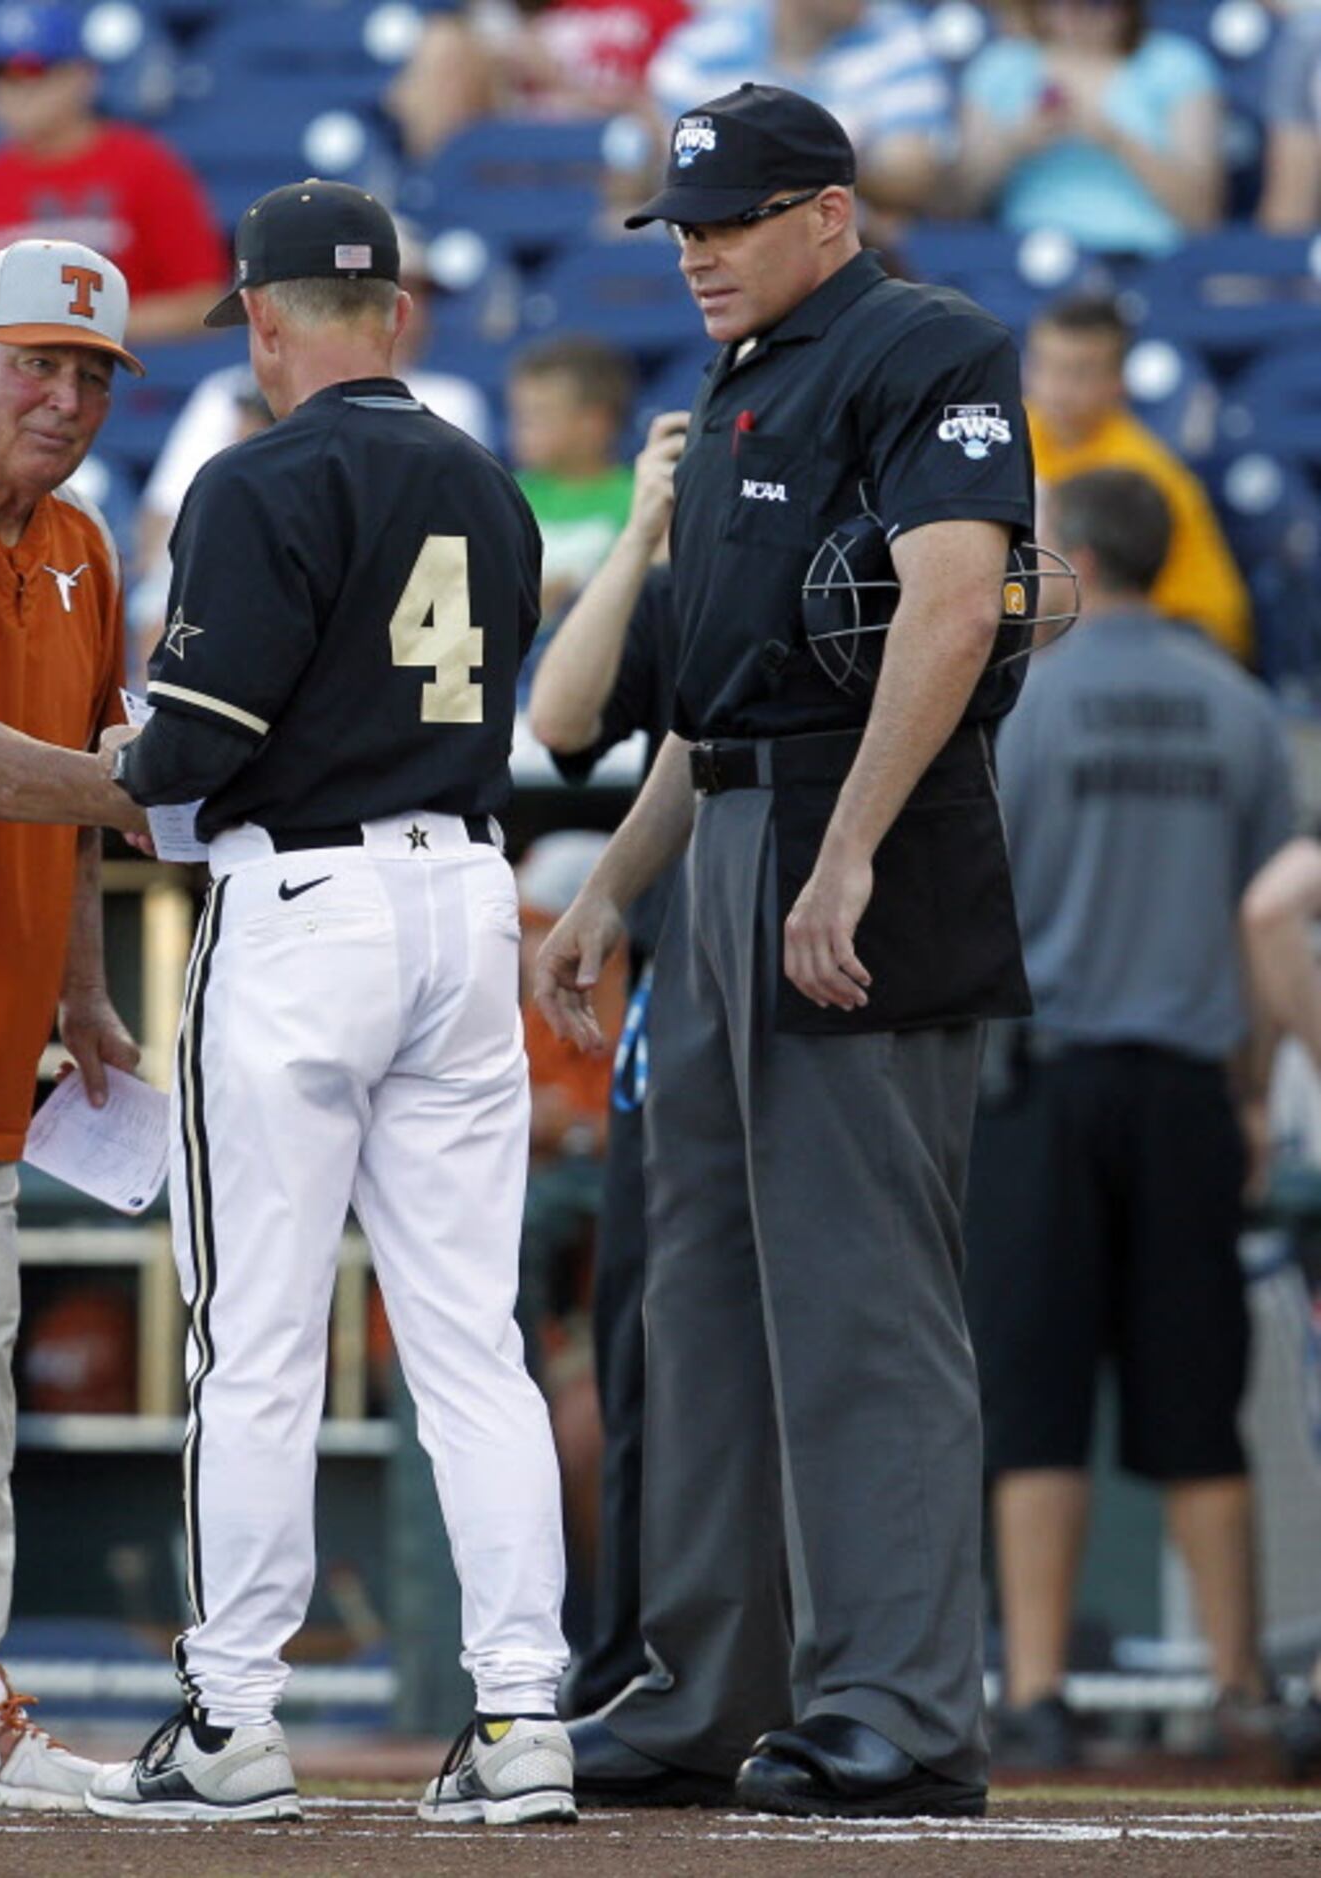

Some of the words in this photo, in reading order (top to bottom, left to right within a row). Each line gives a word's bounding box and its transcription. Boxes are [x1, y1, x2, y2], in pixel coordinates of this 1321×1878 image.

[61, 265, 103, 320] T
[937, 415, 1012, 444] CWS
[740, 479, 788, 501] NCAA
[389, 534, 483, 723] 4
